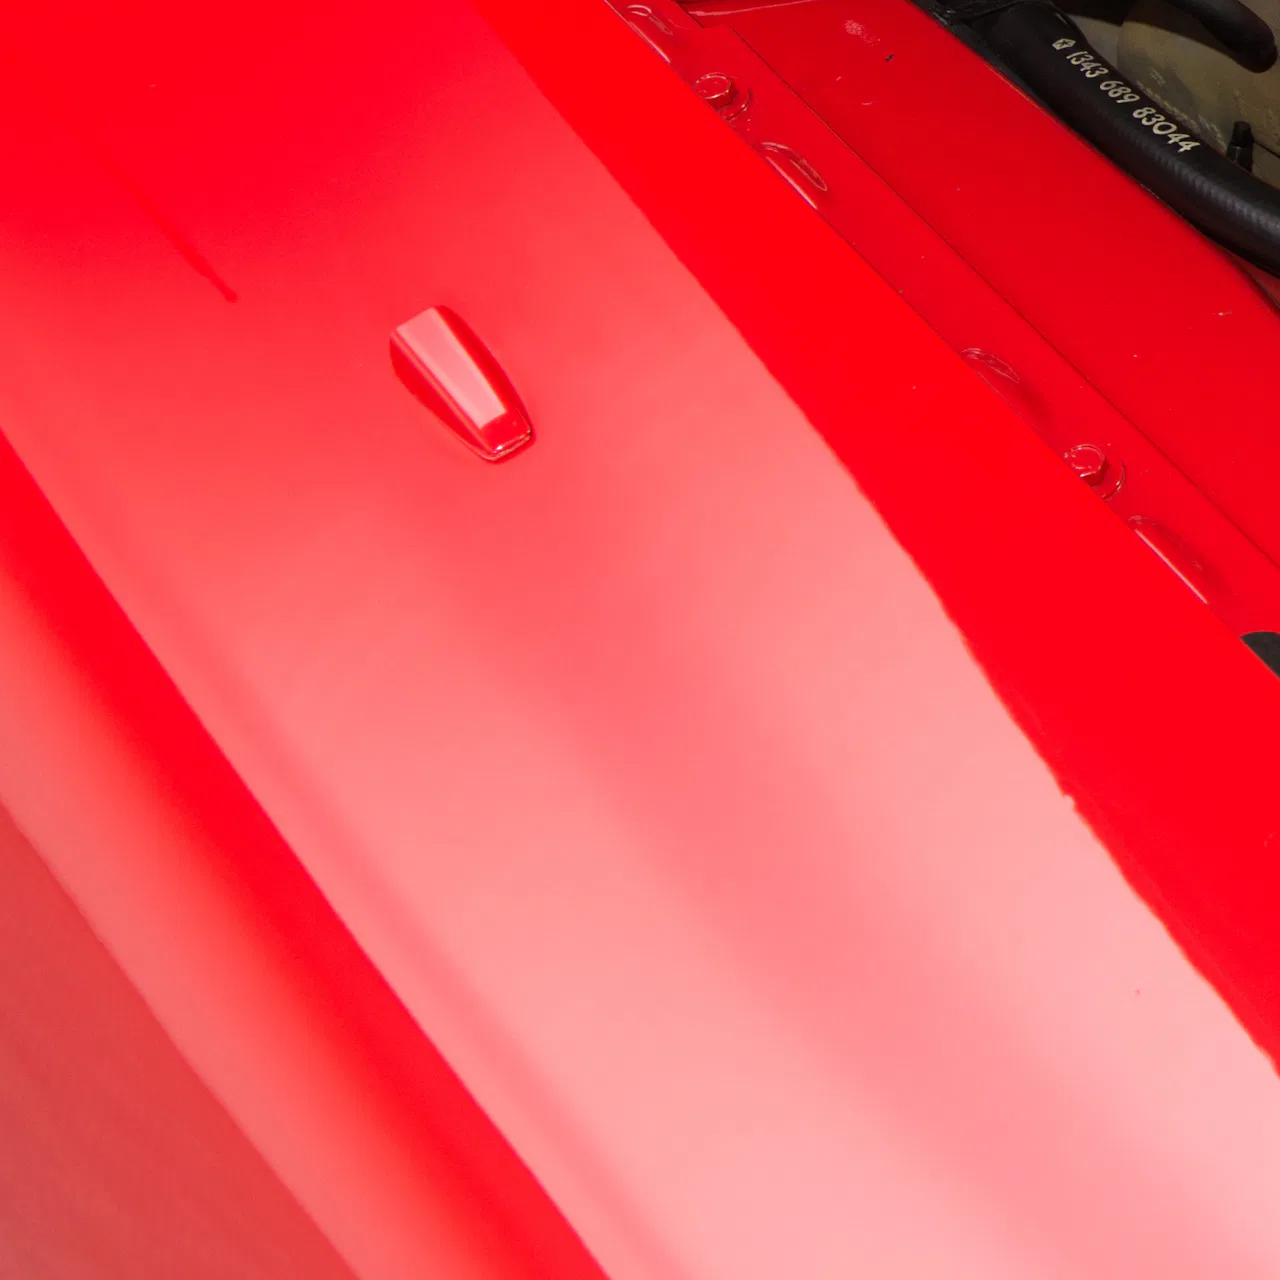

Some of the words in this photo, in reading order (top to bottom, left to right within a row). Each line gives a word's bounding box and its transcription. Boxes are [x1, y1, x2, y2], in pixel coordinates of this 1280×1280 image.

[1066, 51, 1109, 78] 1343
[1100, 80, 1140, 104] 689
[1133, 106, 1201, 153] 83044
